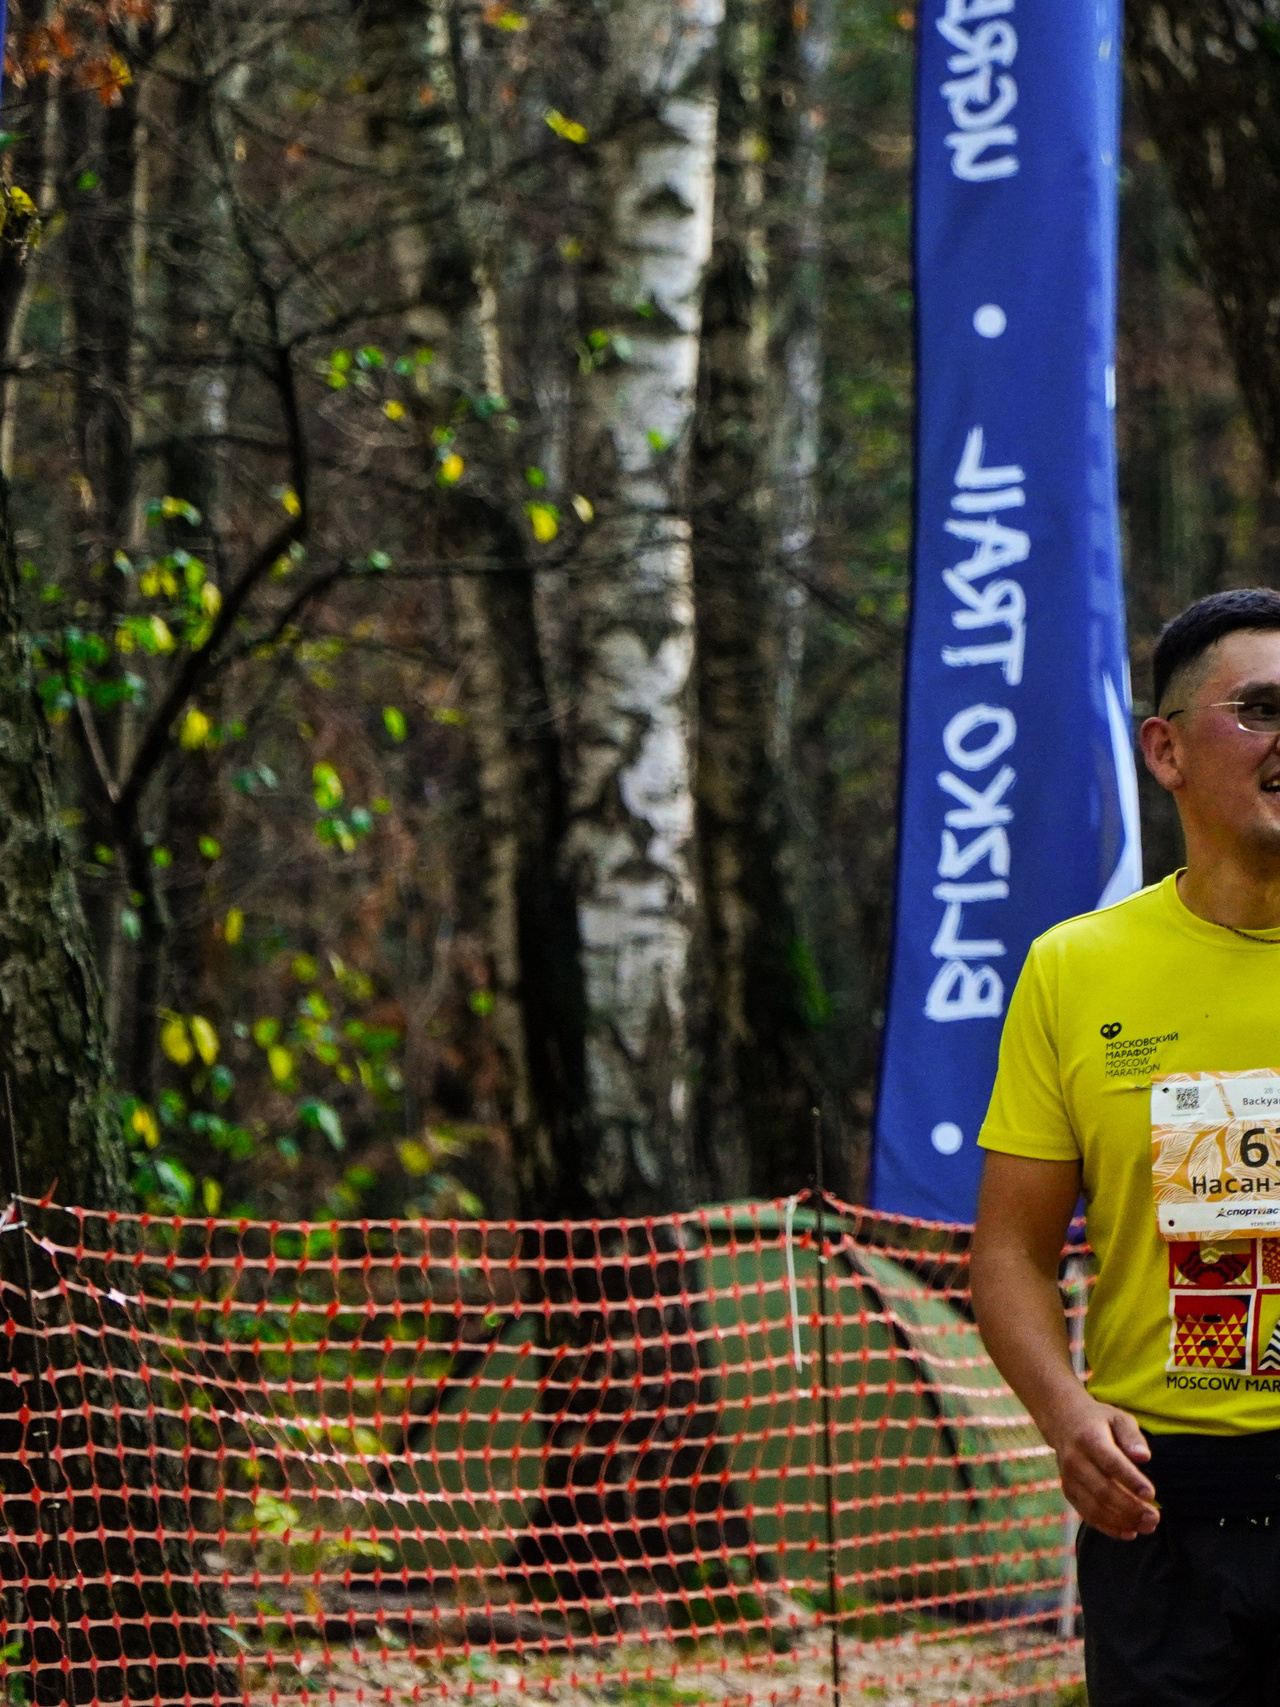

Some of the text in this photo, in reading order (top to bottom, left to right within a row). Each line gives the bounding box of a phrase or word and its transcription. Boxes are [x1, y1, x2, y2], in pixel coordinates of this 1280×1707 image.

[1105, 1032, 1179, 1051] МОСКОВСКИЙ
[1105, 1046, 1157, 1060] МАРАФОН
[1105, 1056, 1151, 1069] MOSCOW
[1105, 1063, 1160, 1078] MARATHON
[1166, 1376, 1241, 1392] MOSCOW
